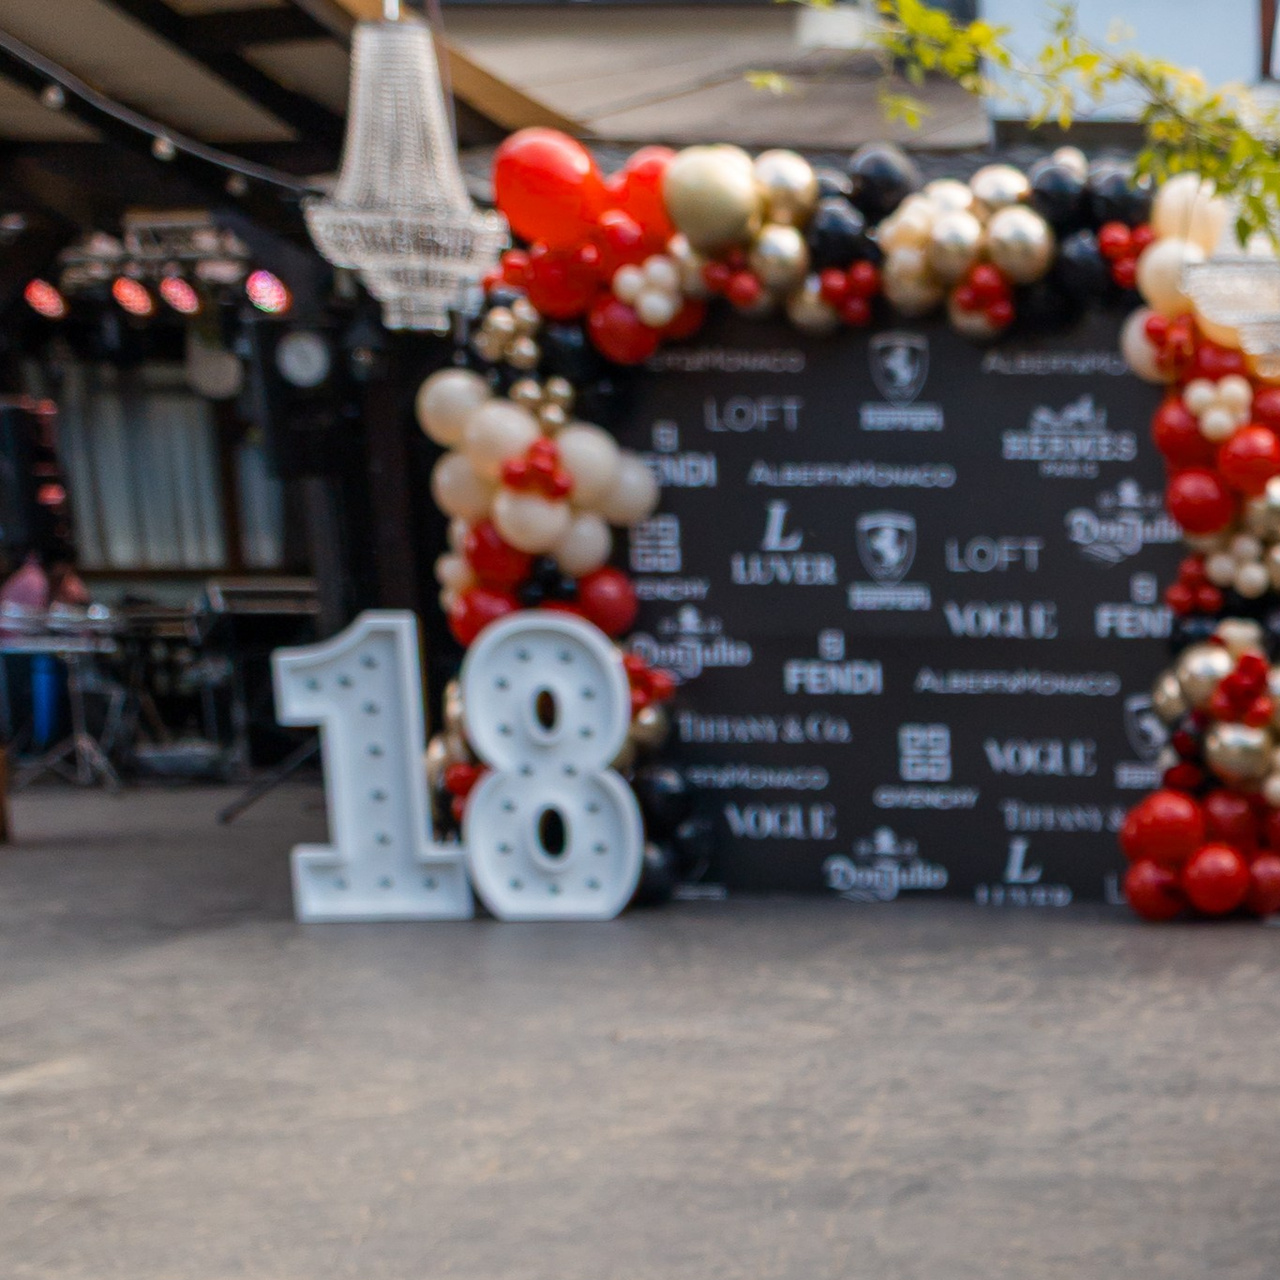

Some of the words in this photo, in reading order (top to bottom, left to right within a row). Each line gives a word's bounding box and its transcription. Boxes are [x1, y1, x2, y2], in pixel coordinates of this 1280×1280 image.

[703, 395, 804, 432] LOFT
[642, 452, 718, 487] ENDI
[945, 536, 1044, 572] LOFT
[944, 600, 1058, 639] VOGUE
[784, 659, 883, 695] FENDI
[271, 609, 644, 922] 18
[984, 738, 1098, 777] VOGUE
[724, 802, 838, 840] VOGUE
